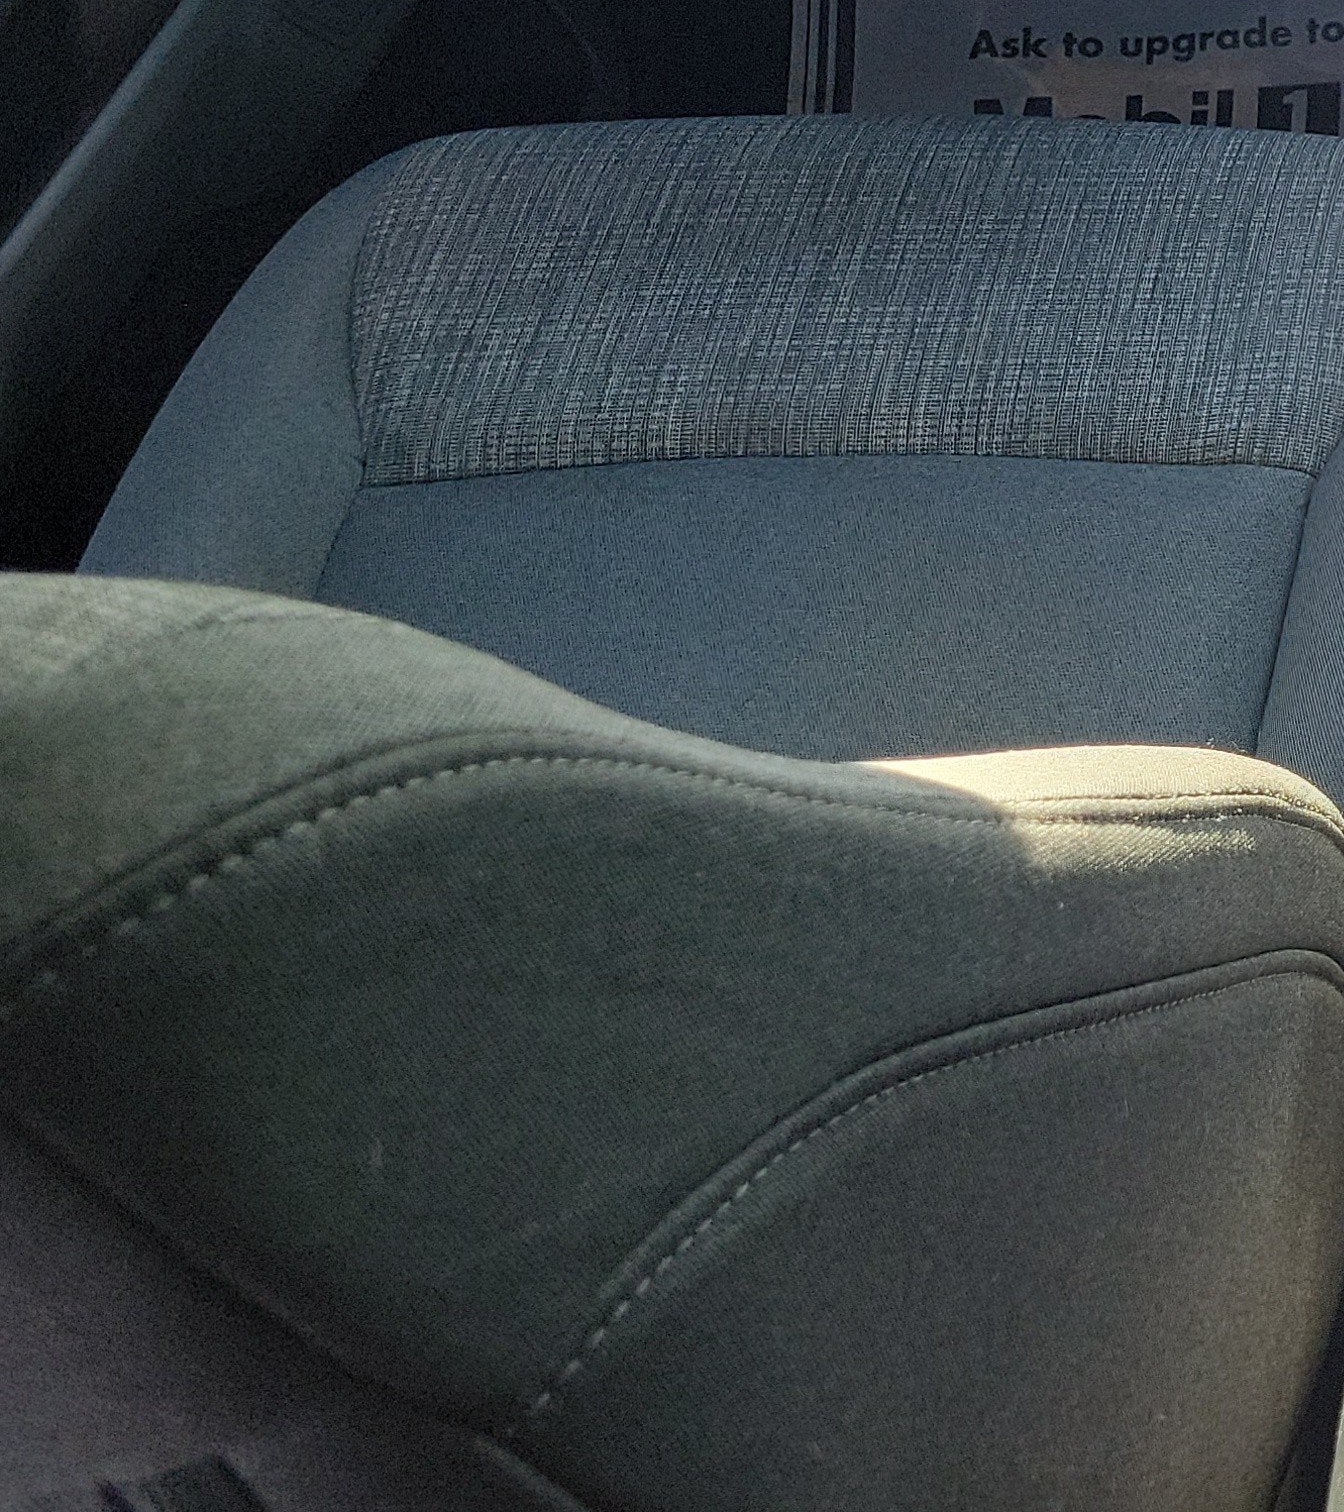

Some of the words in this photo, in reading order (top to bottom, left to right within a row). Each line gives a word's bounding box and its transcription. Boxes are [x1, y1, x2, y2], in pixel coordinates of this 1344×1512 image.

[969, 26, 1047, 60] Ask
[1062, 31, 1103, 59] to
[1119, 16, 1292, 65] upgrade
